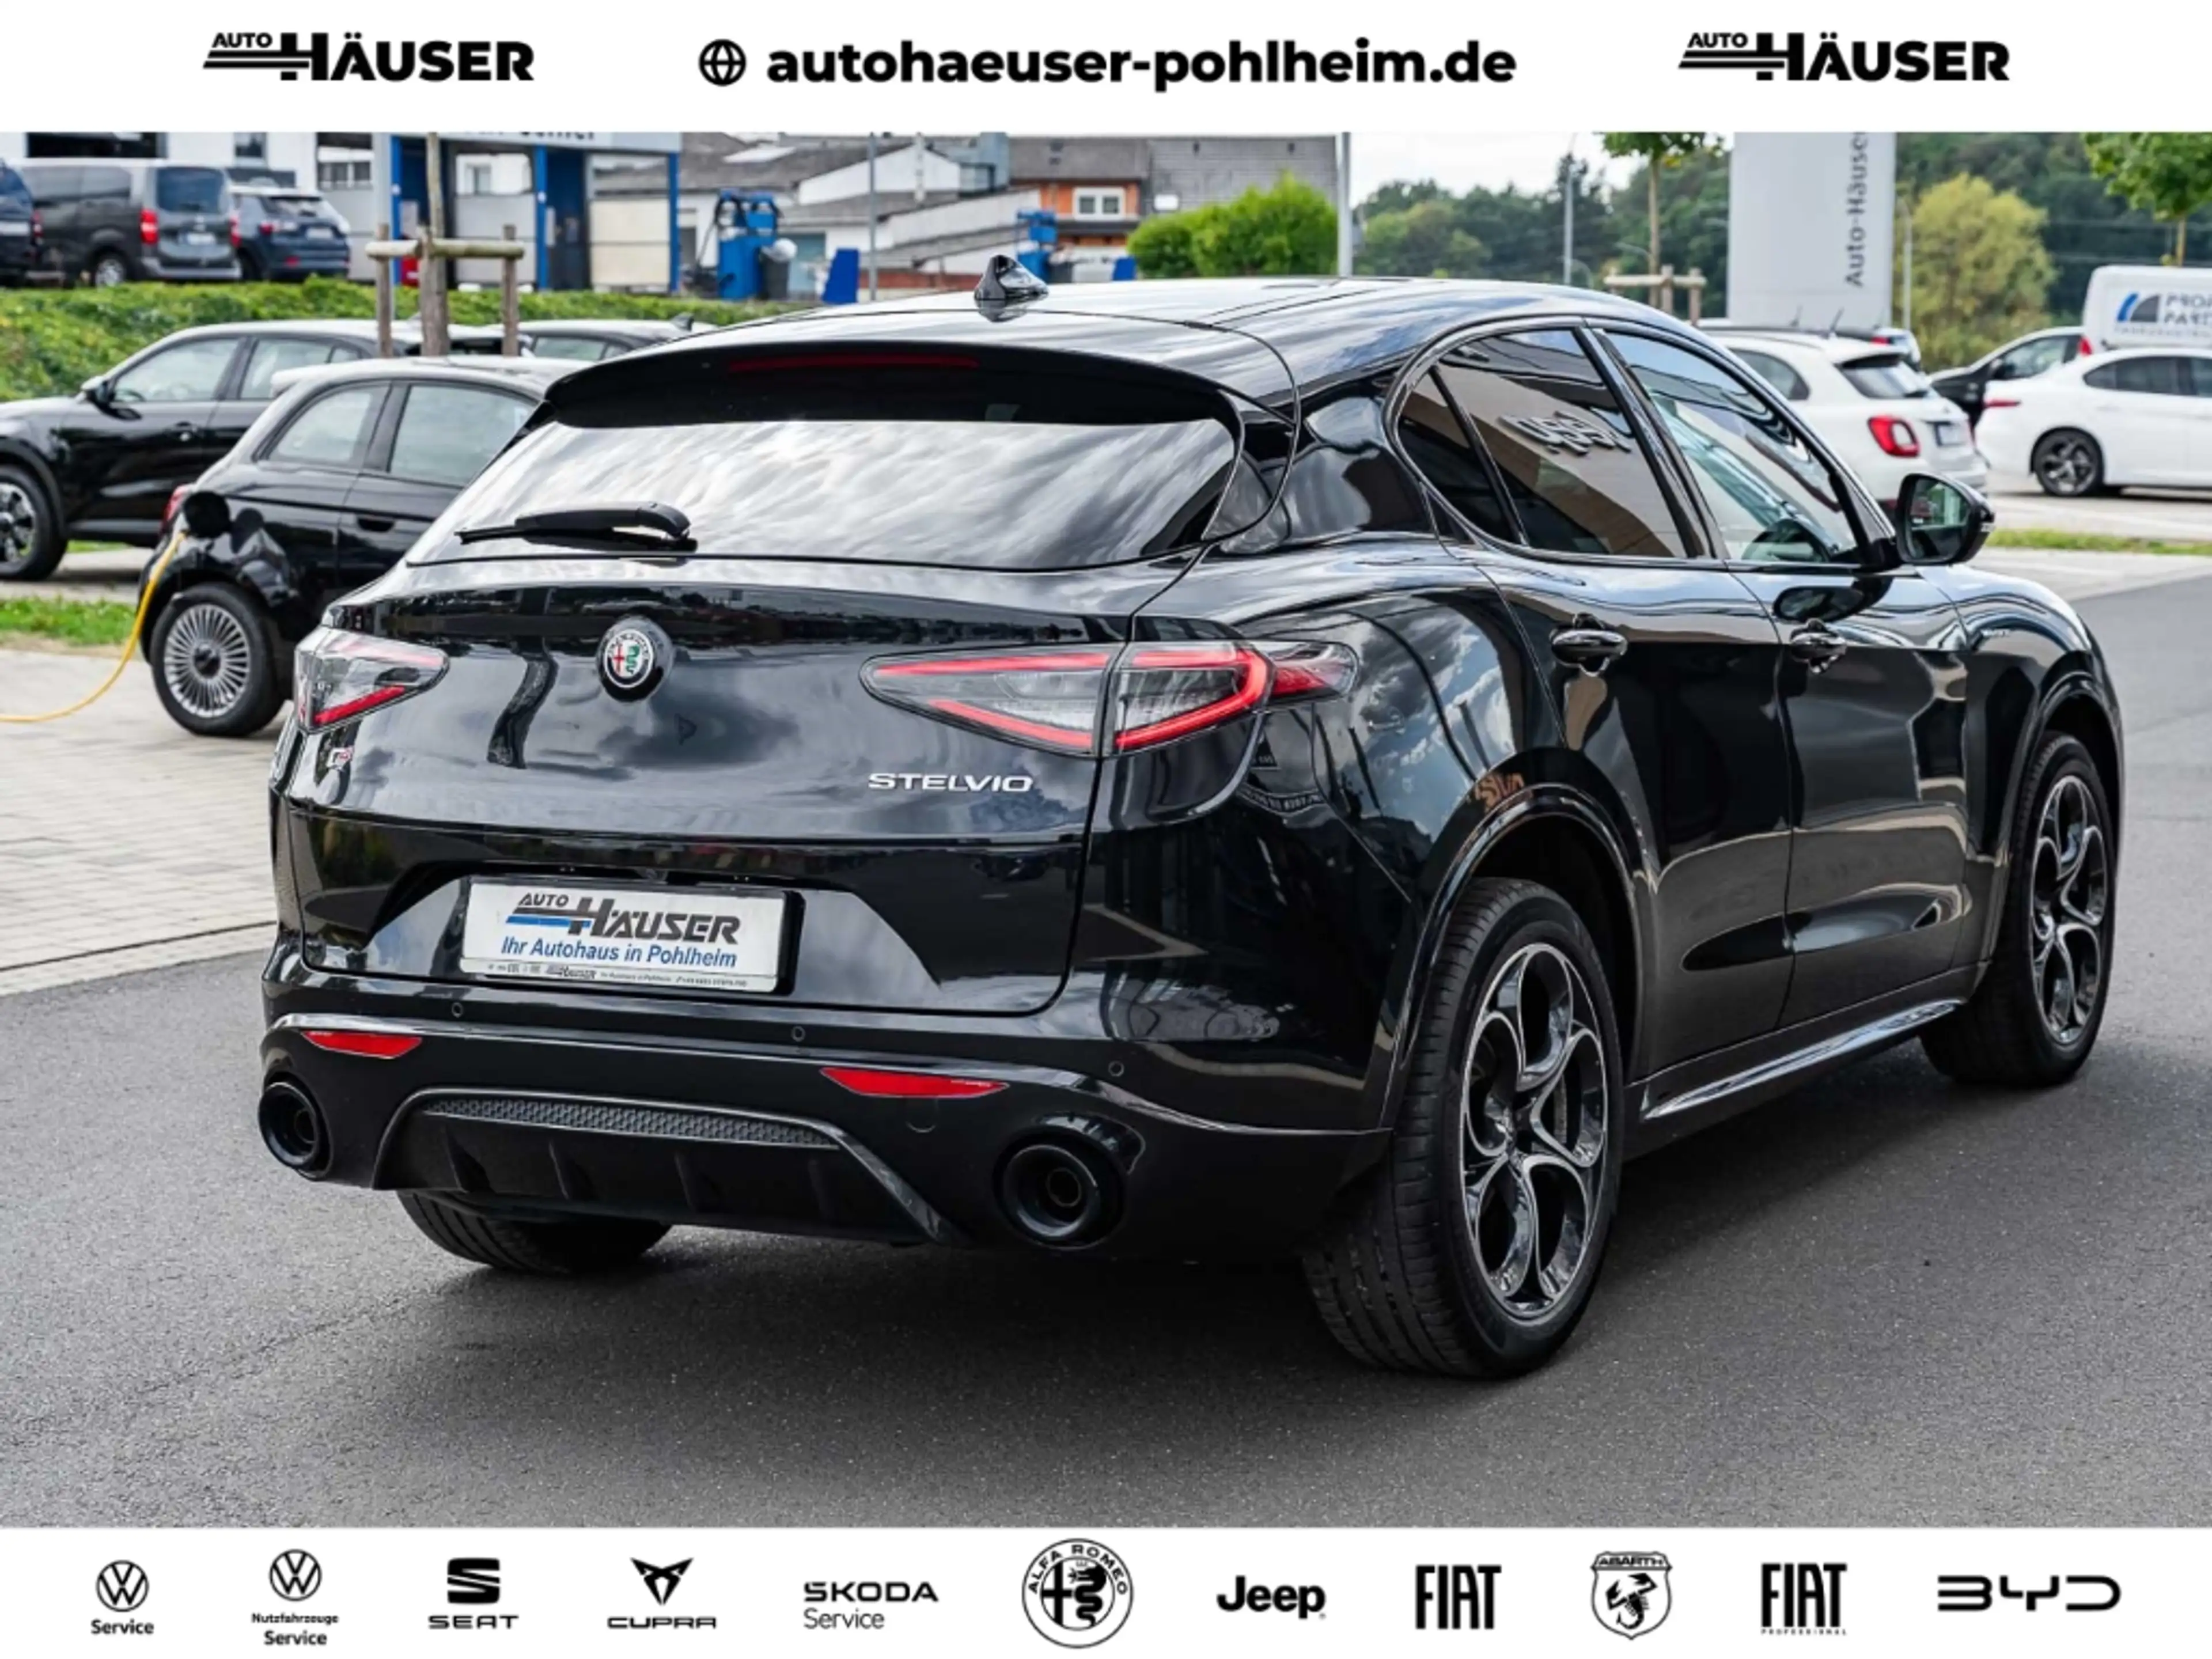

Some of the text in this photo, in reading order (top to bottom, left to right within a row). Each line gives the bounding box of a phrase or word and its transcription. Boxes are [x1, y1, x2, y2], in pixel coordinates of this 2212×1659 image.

[1844, 132, 1868, 289] Auto-Häuse
[868, 772, 1033, 792] STELVIO
[518, 892, 742, 945] AUTO HÄUSER
[501, 935, 738, 968] Ihr Autohaus in Pohlheim
